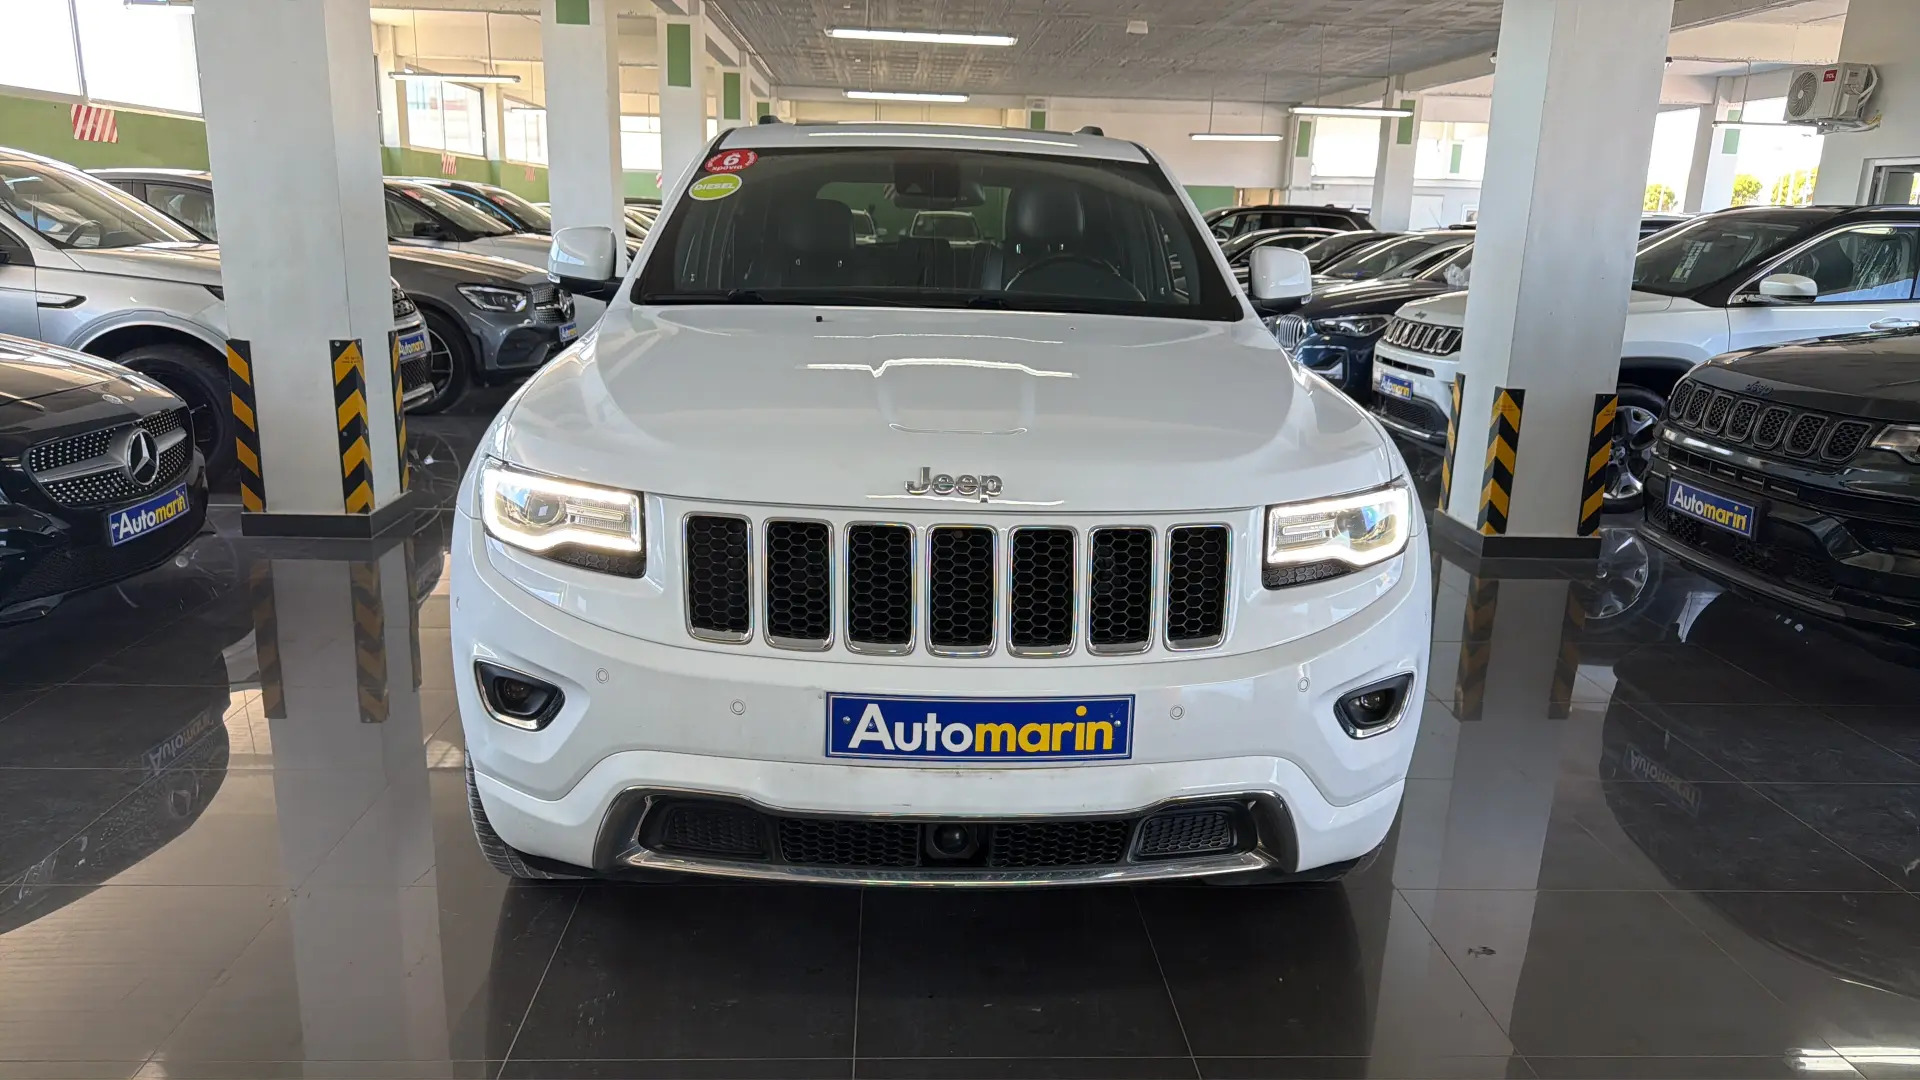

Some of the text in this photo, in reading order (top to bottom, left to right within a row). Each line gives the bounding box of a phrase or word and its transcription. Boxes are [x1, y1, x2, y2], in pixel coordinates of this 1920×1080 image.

[723, 154, 741, 166] 6
[694, 182, 736, 191] DIESEL
[905, 466, 1003, 503] Jeep
[119, 490, 187, 540] Automarin
[1672, 484, 1747, 531] Automarin
[848, 703, 1114, 753] Automarin
